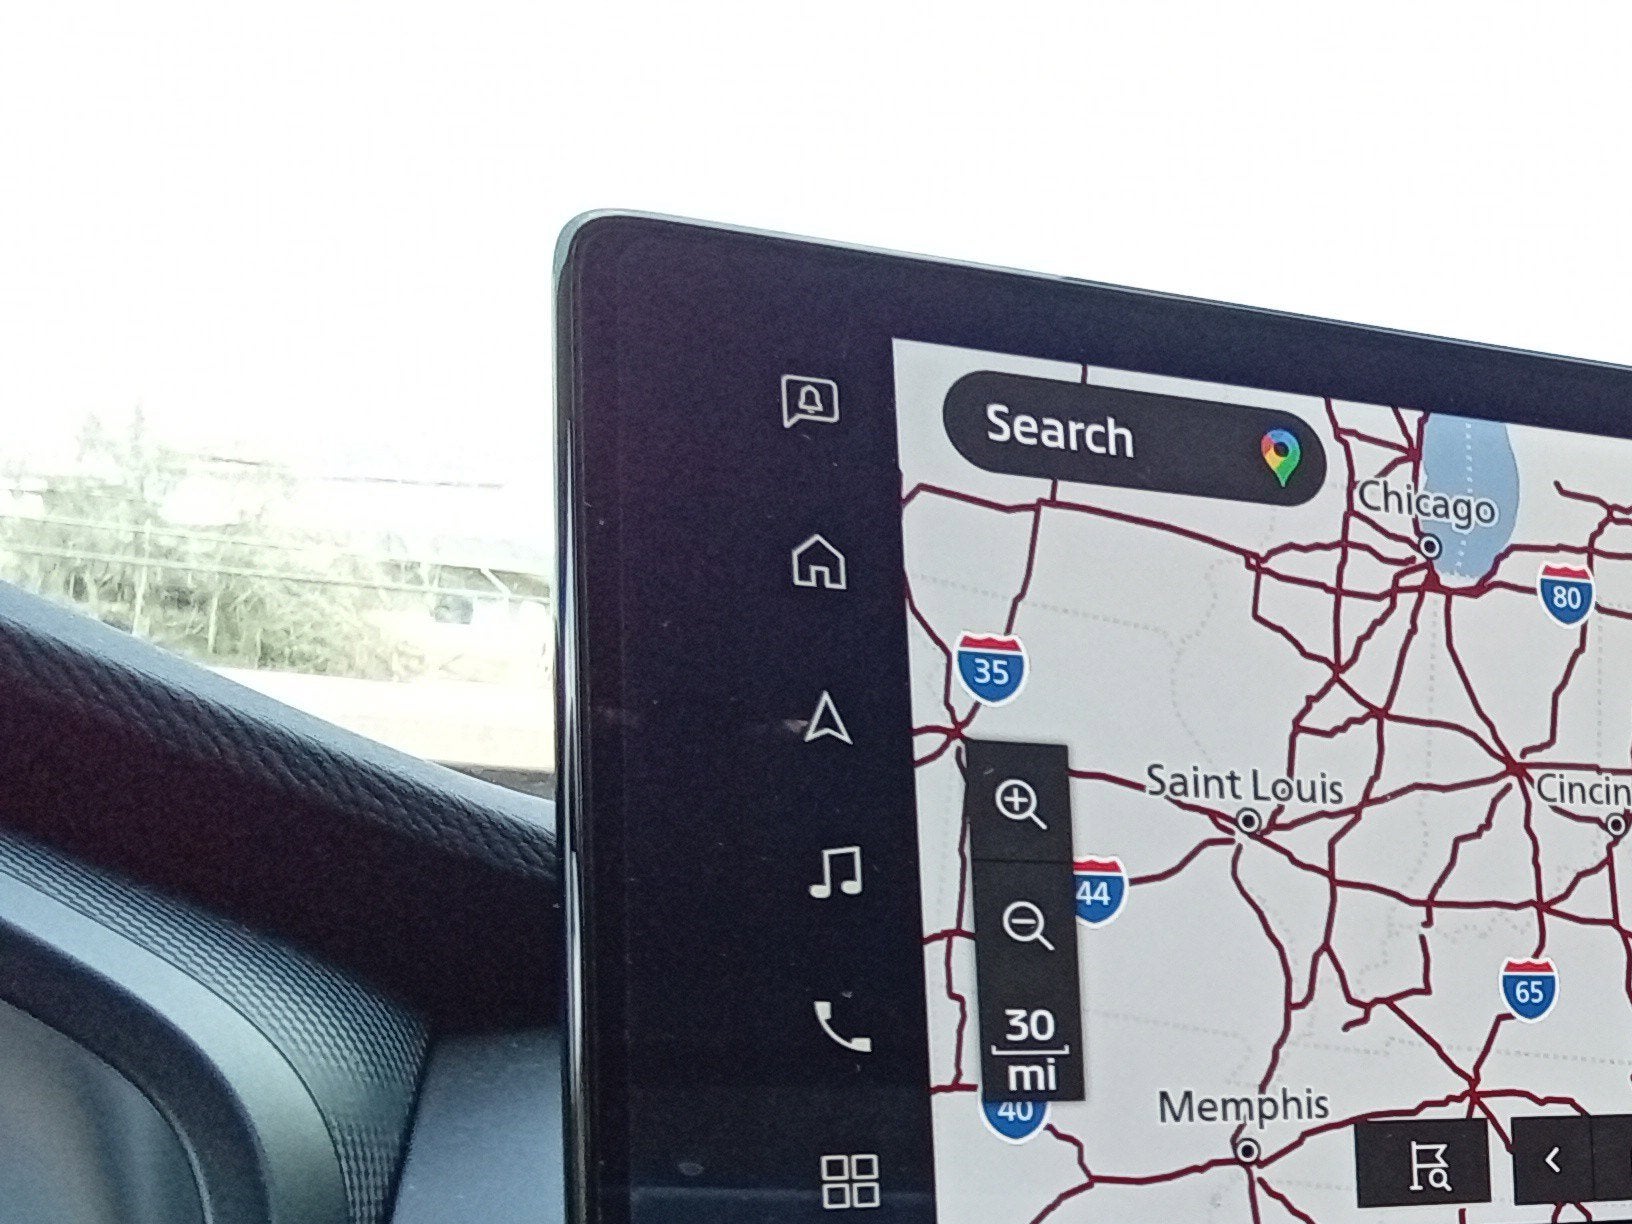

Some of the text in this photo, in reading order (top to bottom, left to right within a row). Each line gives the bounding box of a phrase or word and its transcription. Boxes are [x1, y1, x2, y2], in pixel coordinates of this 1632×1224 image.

[985, 403, 1135, 459] Search
[1358, 479, 1496, 529] Chicago
[1553, 586, 1582, 609] 80
[974, 660, 1009, 685] 35
[1146, 764, 1344, 805] Saint Louis
[1076, 882, 1110, 905] 44
[1515, 981, 1543, 1003] 65
[1005, 1009, 1055, 1041] 30
[1008, 1057, 1057, 1091] mi
[997, 1101, 1033, 1121] 40
[1160, 1091, 1329, 1126] Memphis
